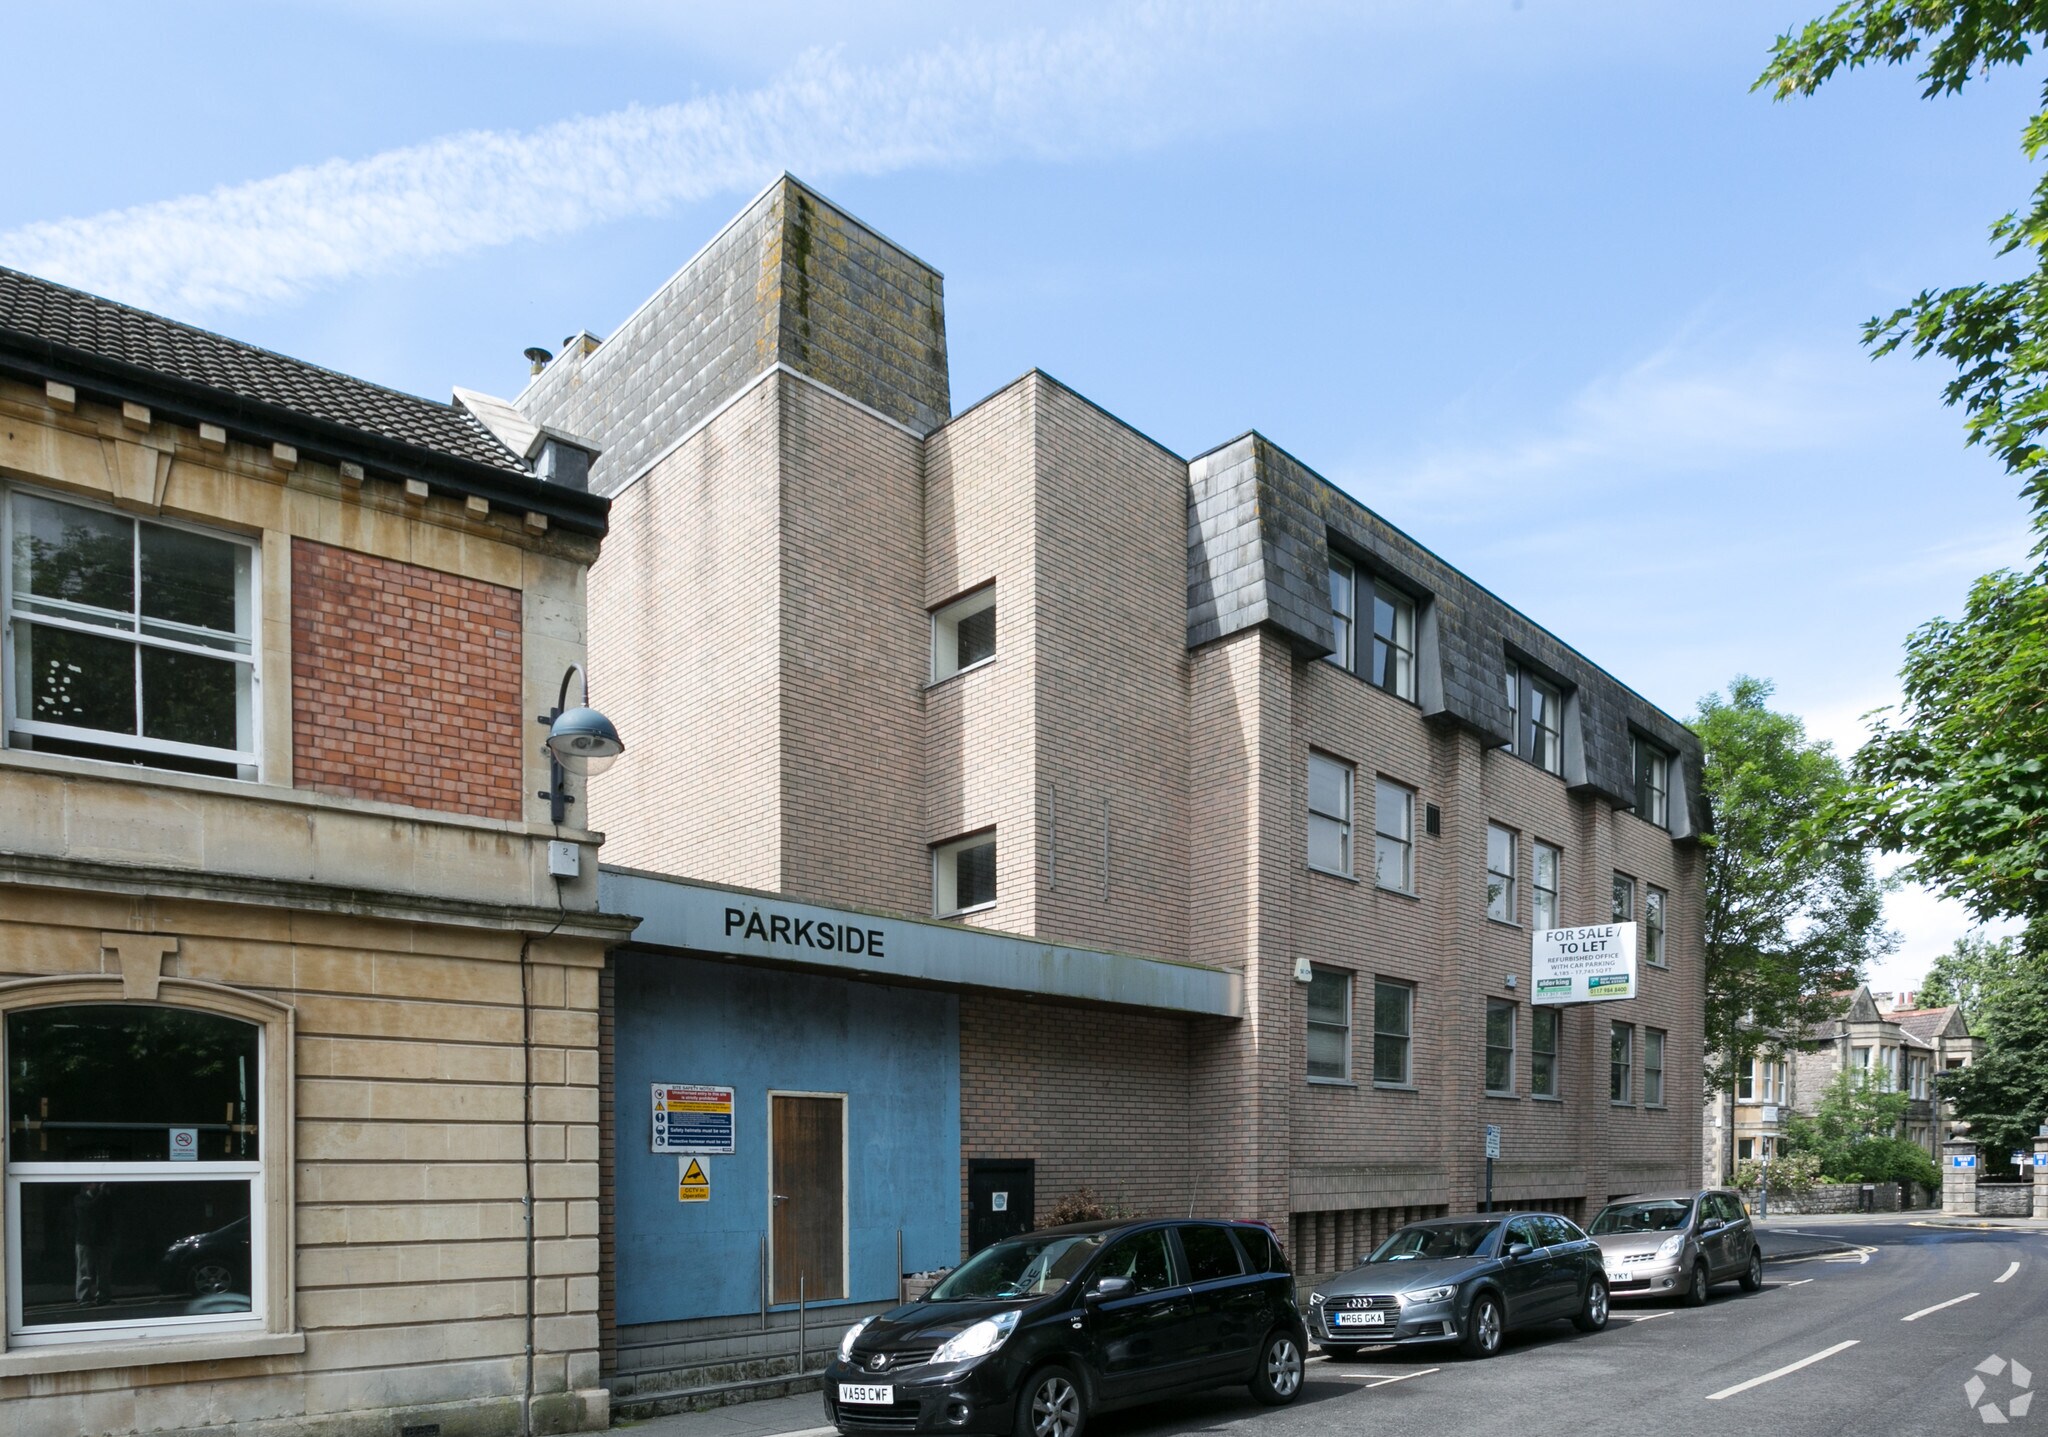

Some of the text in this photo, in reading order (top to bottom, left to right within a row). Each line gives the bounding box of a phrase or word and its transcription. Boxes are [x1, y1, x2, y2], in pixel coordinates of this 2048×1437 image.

[562, 847, 569, 856] 2
[725, 907, 885, 958] PARKSIDE
[1546, 926, 1622, 942] FOR SALE /
[1559, 940, 1607, 954] TO LET
[1547, 952, 1619, 963] REFURBISHED OFFICE
[1551, 960, 1616, 970] WITH CAR PARKING
[1538, 978, 1570, 987] alder king
[1613, 1272, 1628, 1280] YKY
[1340, 1313, 1383, 1323] WR66 GKA
[842, 1386, 888, 1402] VA59 CWF
